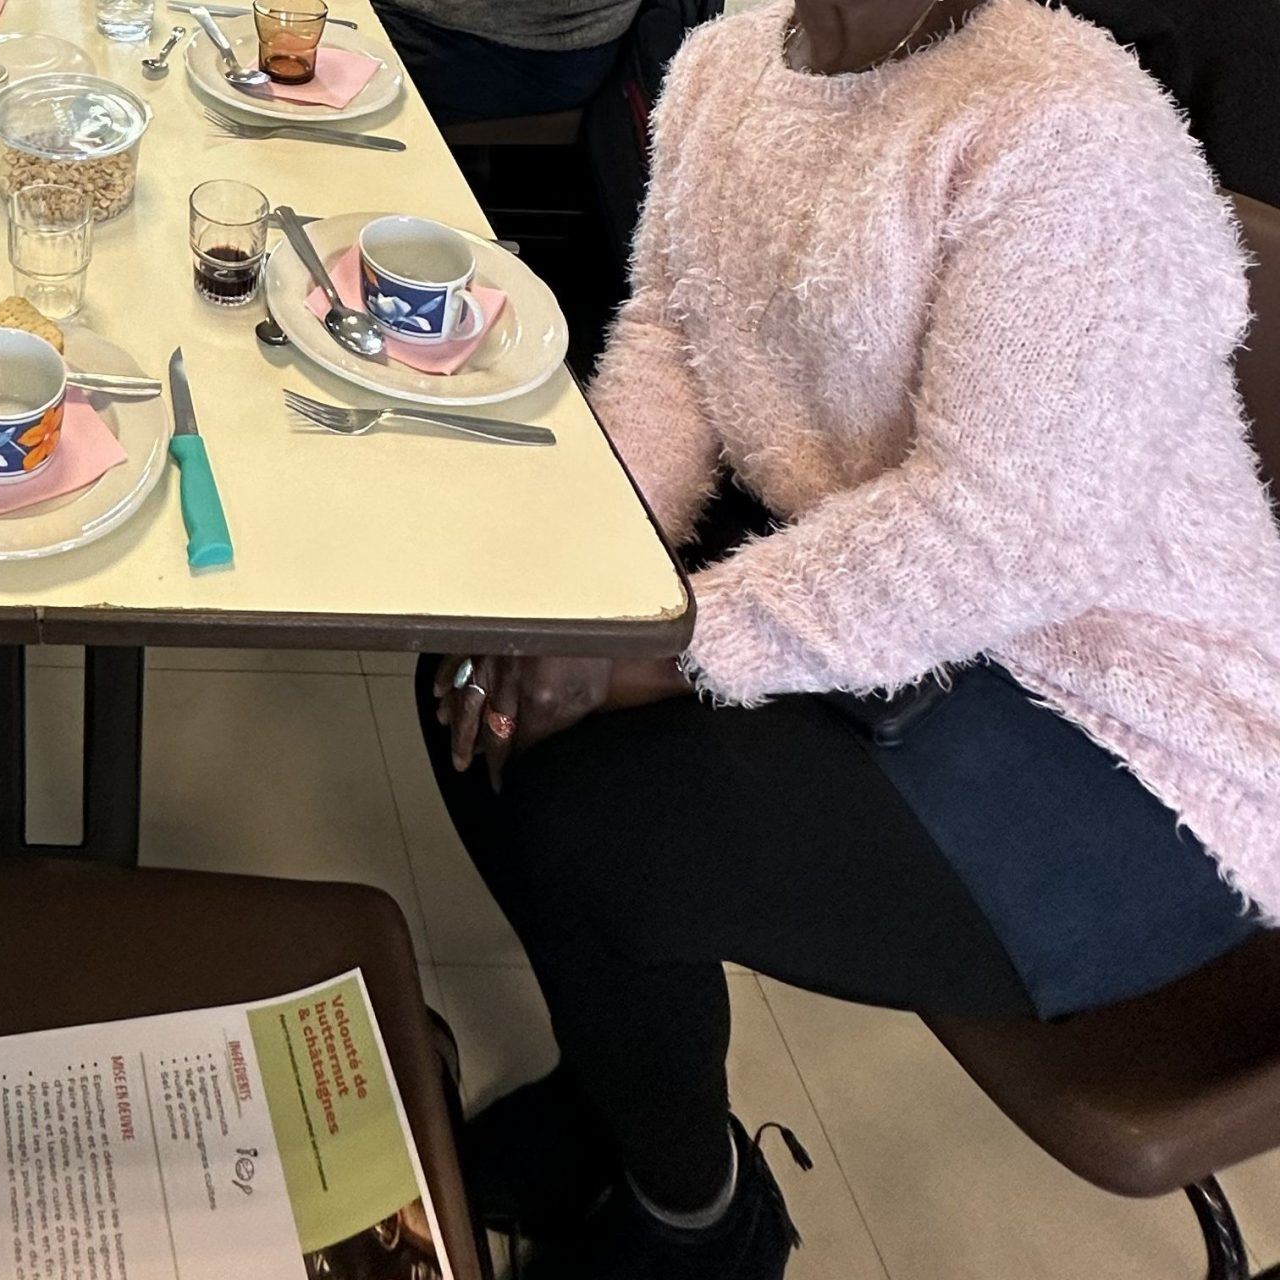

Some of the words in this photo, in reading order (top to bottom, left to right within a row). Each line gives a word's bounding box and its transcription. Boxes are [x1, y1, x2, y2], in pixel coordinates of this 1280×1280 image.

[298, 1007, 311, 1021] &
[315, 1001, 349, 1097] butternut
[331, 994, 361, 1070] Velouté
[354, 1073, 368, 1100] de
[111, 1055, 126, 1083] MISE
[161, 1071, 171, 1090] Sel
[228, 1040, 252, 1101] INGRÉDIENTS
[303, 1024, 339, 1135] châtaignes
[41, 1081, 50, 1097] de
[115, 1084, 129, 1099] EN
[173, 1070, 183, 1099] Huile
[189, 1089, 197, 1103] de
[199, 1076, 212, 1120] oignons
[27, 1083, 38, 1129] Ajouter
[67, 1078, 77, 1109] Faire
[72, 1115, 83, 1159] revenir
[32, 1134, 41, 1154] les
[45, 1124, 53, 1138] et
[8, 1168, 16, 1182] et
[87, 1135, 96, 1149] et
[97, 1209, 106, 1230] les
[100, 1132, 109, 1147] et
[111, 1208, 120, 1229] les
[52, 1187, 62, 1221] cuire
[42, 1235, 51, 1254] en
[55, 1225, 66, 1242] 20
[29, 1250, 38, 1268] du
